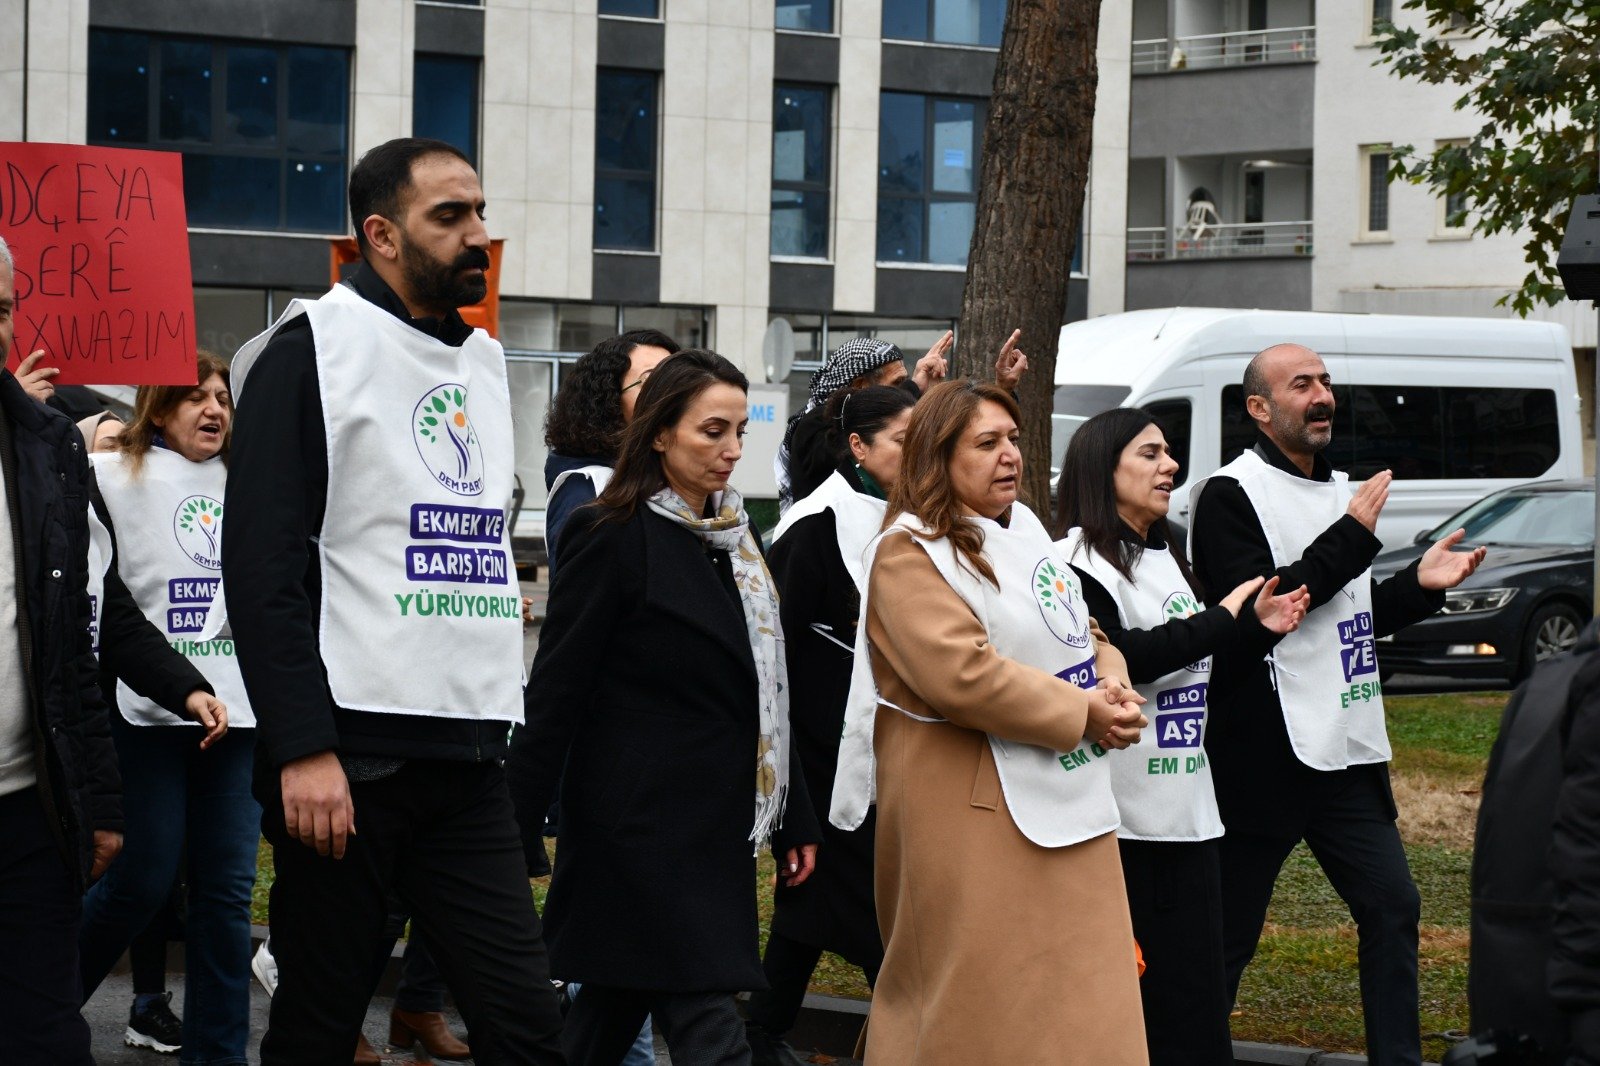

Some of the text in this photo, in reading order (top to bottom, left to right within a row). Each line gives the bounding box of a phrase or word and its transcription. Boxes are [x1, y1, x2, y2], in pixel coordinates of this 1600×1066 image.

[0, 161, 155, 232] DÇEYA
[746, 404, 775, 422] ME
[438, 471, 459, 491] DEM
[418, 510, 502, 537] EKMEK VE
[193, 552, 222, 568] DEM PA
[412, 548, 505, 583] BARIŞ İÇİN
[174, 582, 218, 599] EKME
[394, 589, 520, 619] YÜRÜYORUZ
[172, 611, 209, 629] BAR
[1162, 695, 1173, 707] JI
[1178, 689, 1200, 704] BO
[1058, 748, 1091, 771] EM
[1148, 758, 1178, 775] EM
